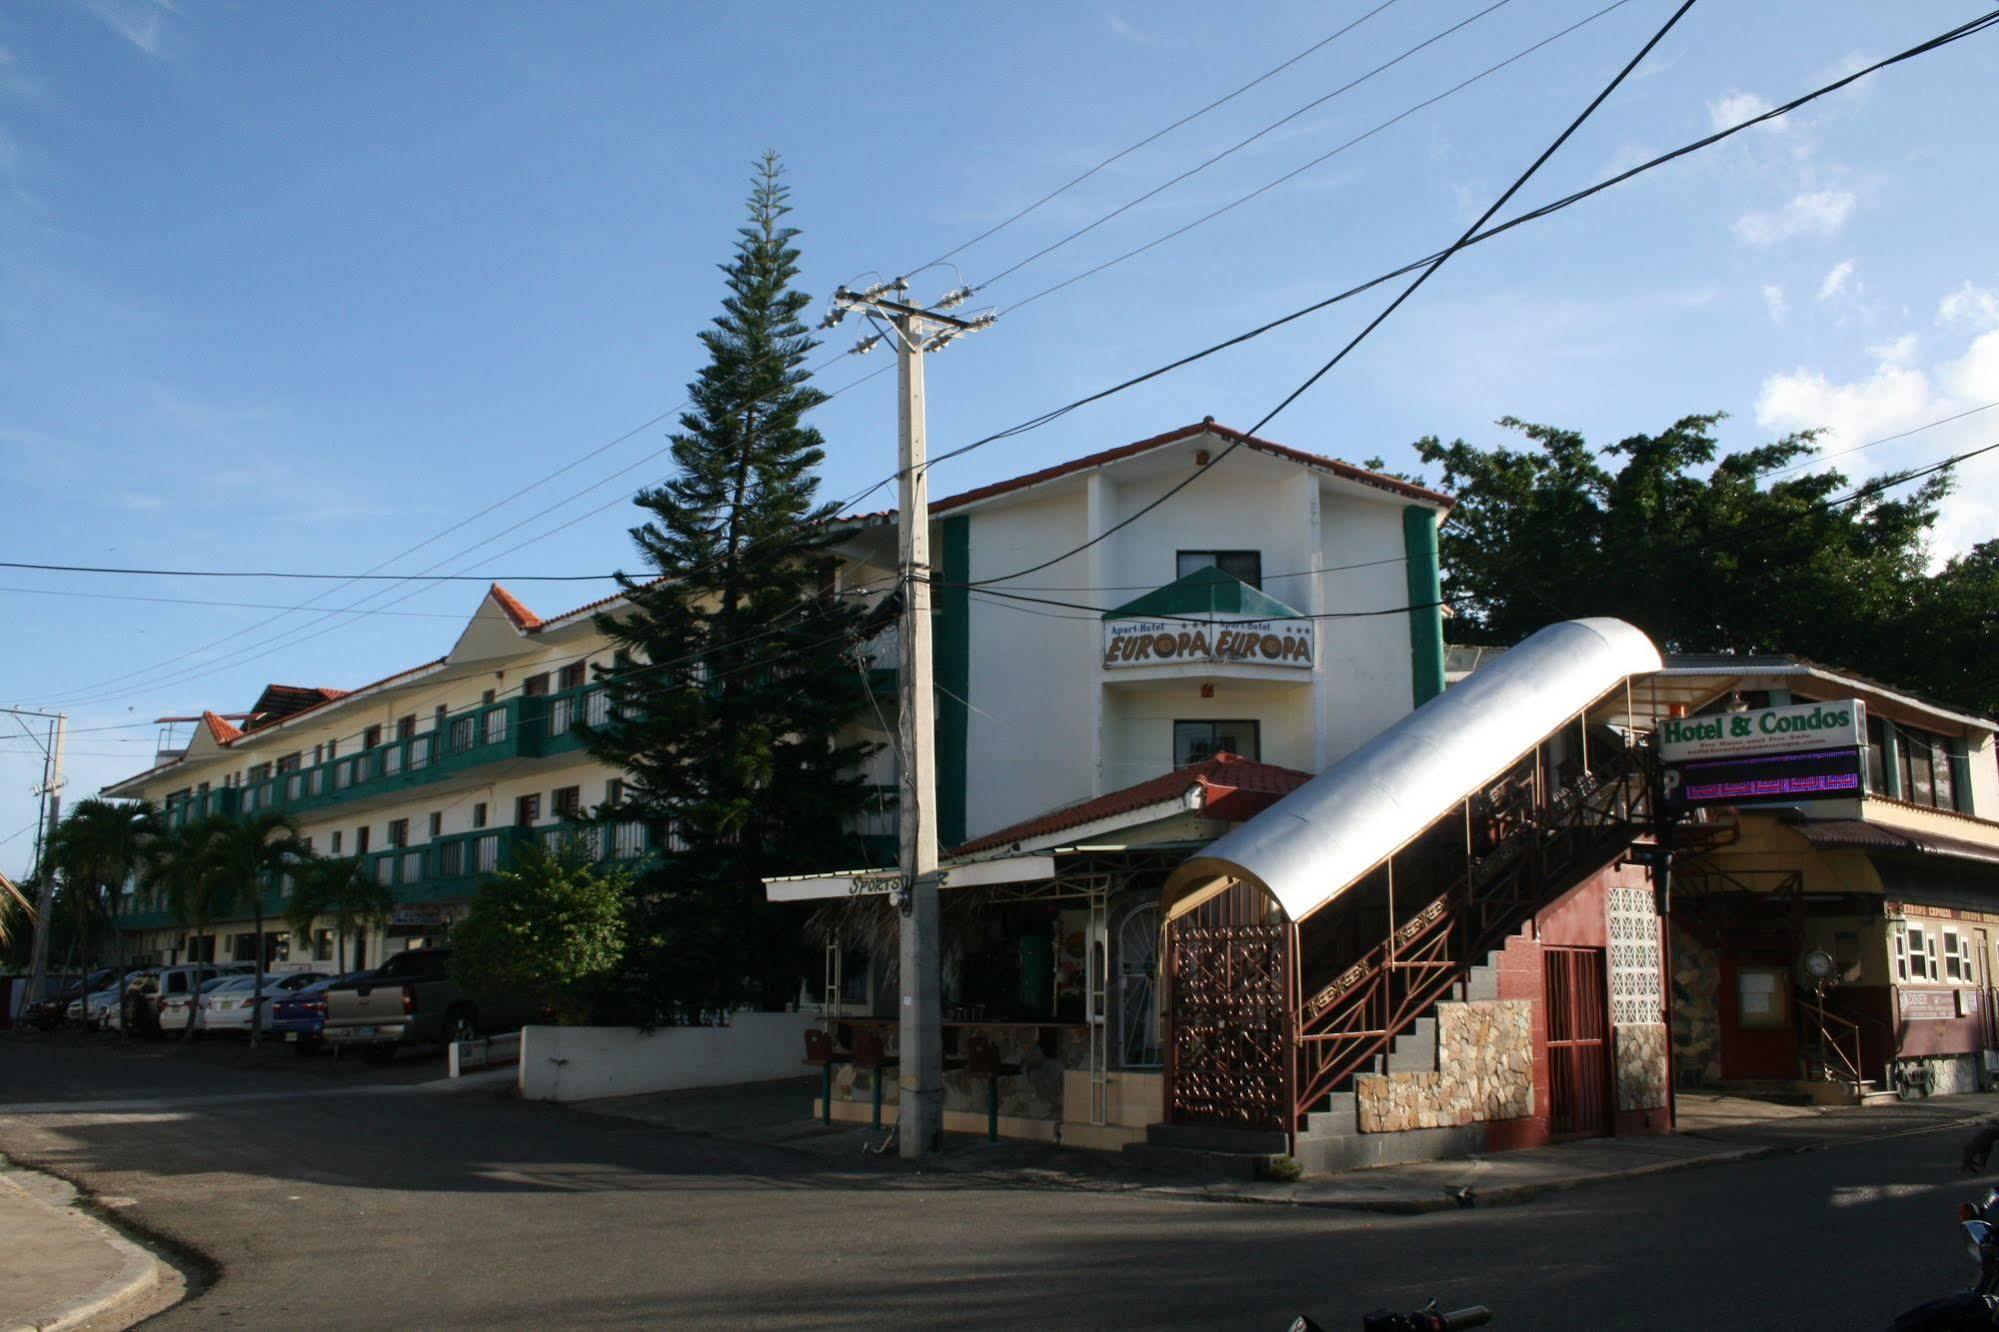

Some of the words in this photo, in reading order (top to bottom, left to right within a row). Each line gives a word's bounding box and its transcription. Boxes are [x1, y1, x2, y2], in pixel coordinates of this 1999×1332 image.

[1107, 630, 1210, 662] EUROPA
[1214, 630, 1312, 662] EUROPA
[1664, 718, 1722, 743] Hotel
[1730, 716, 1751, 737] &
[1759, 707, 1850, 734] Condos
[849, 876, 900, 895] SPORTS
